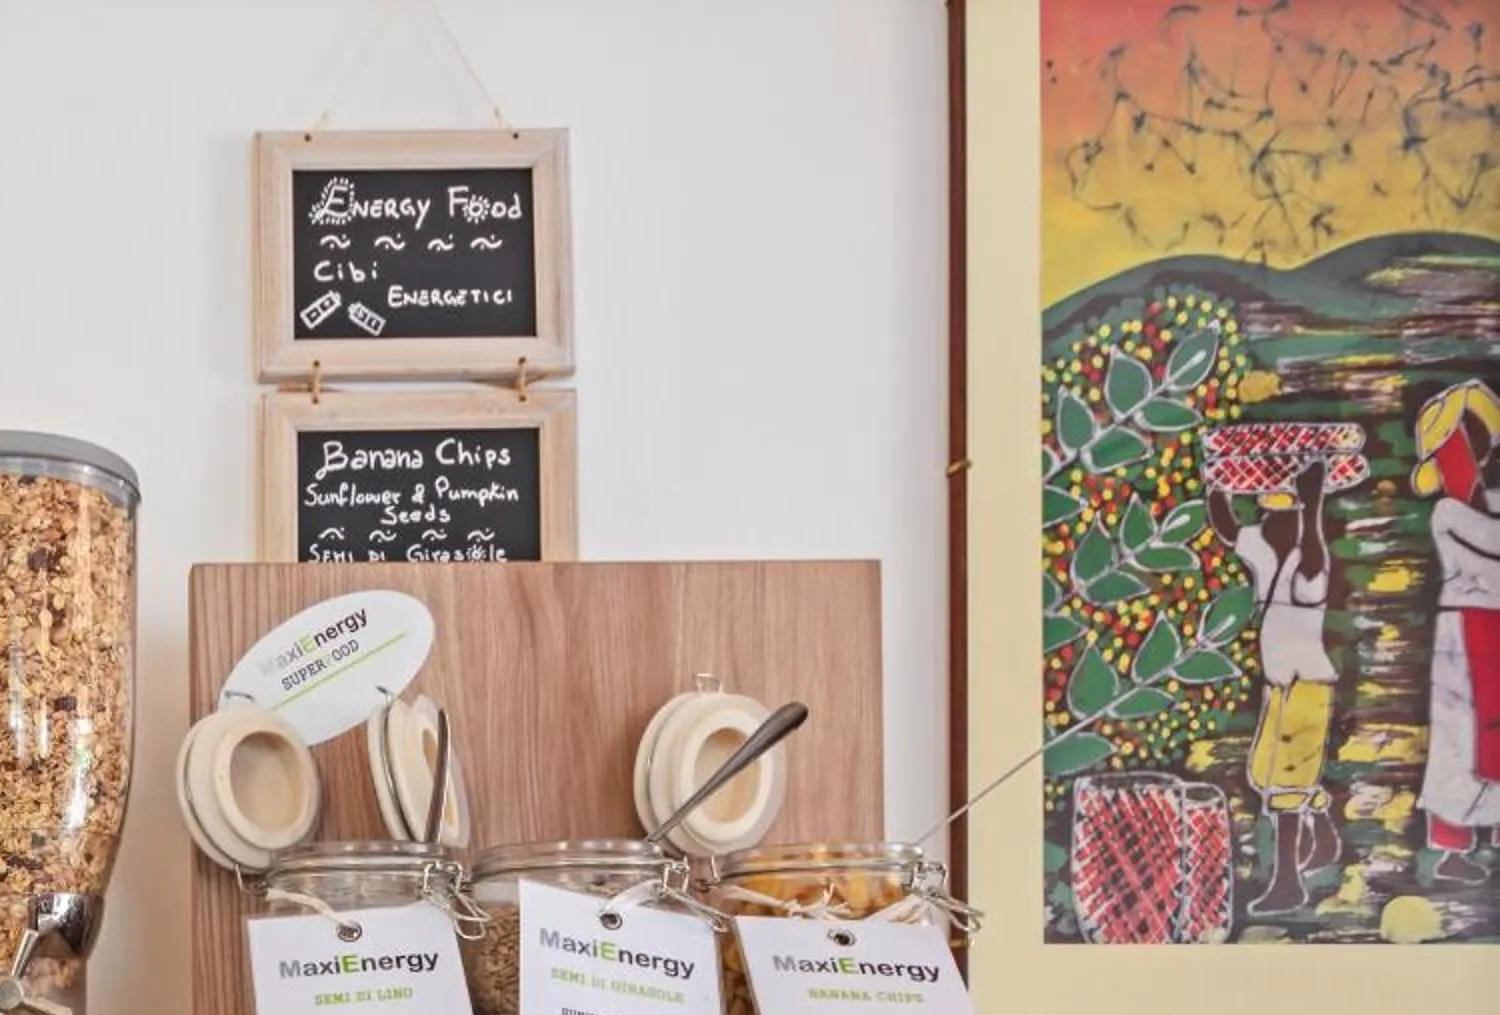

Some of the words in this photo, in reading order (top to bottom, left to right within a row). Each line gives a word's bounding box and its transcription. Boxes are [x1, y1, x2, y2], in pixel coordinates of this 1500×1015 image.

[315, 440, 424, 480] Banana
[435, 438, 512, 470] Chips
[304, 482, 402, 507] Sunflower
[411, 483, 426, 505] &
[435, 475, 519, 507] Pumpkin
[380, 504, 451, 526] Seeds
[279, 952, 439, 980] MaxiEnergy
[539, 927, 696, 981] MaxiEnergy
[772, 955, 940, 983] MaxiEnergy
